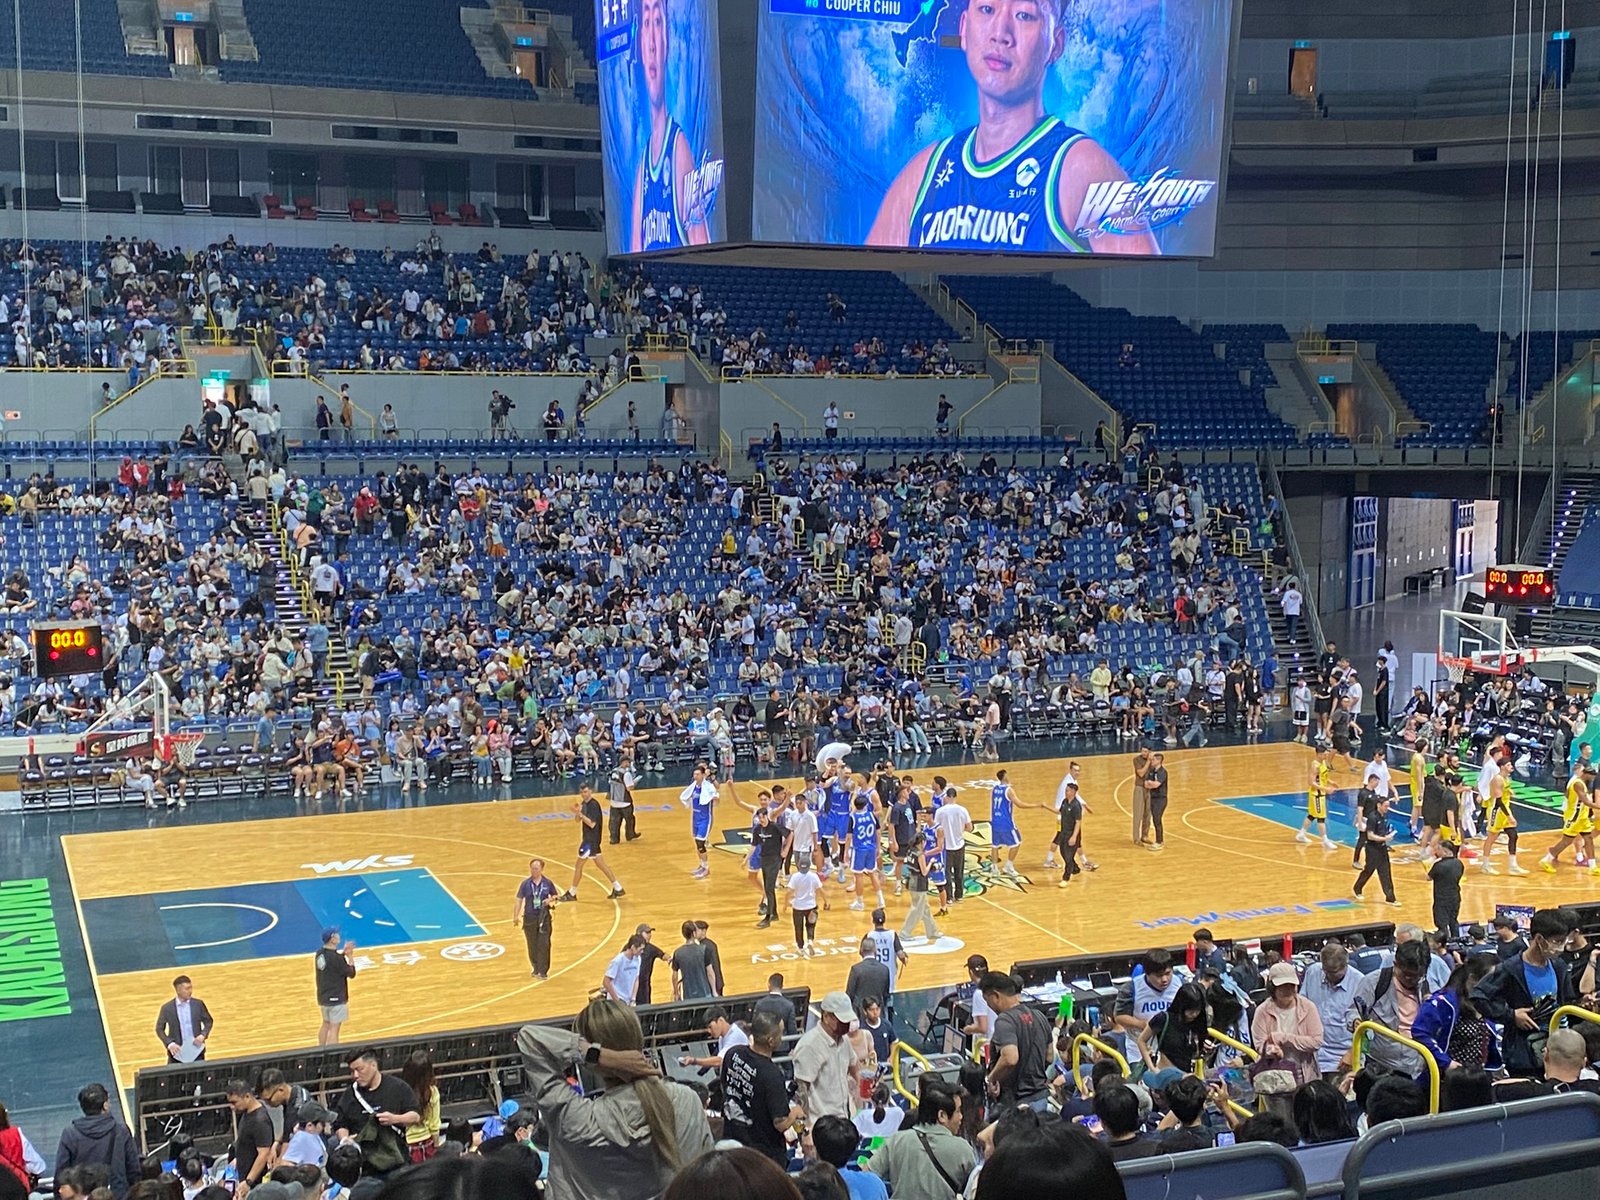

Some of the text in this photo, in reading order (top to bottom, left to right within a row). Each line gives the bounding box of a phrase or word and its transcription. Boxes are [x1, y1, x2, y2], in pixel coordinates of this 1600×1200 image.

[825, 0, 871, 13] COOPER
[873, 0, 901, 15] CHIU
[1489, 570, 1508, 584] 00.0
[1521, 572, 1544, 586] 00.0
[51, 631, 85, 649] 00.0
[857, 823, 875, 839] 30
